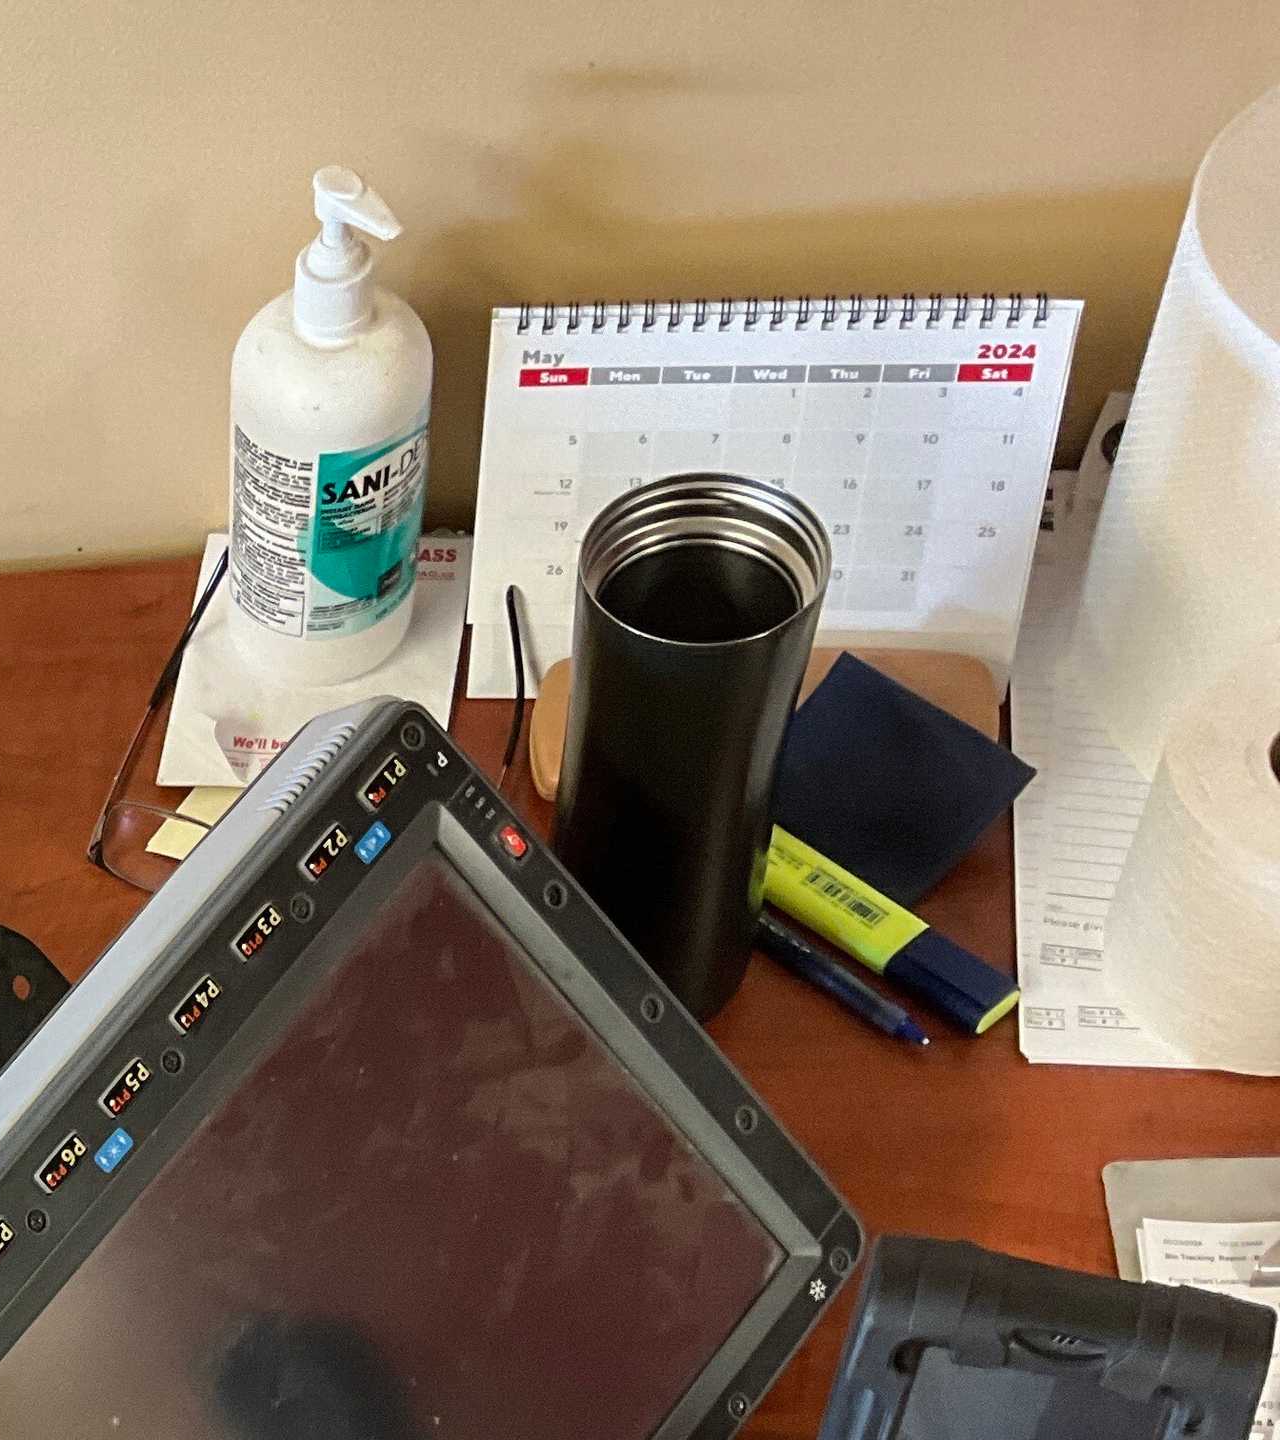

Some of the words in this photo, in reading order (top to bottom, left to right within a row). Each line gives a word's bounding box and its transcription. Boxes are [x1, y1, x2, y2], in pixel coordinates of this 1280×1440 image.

[522, 350, 565, 367] May
[977, 344, 1037, 360] 2024
[540, 372, 568, 383] Sun
[609, 371, 640, 382] Mon
[684, 370, 711, 381] Tue
[753, 369, 788, 380] Wed
[830, 368, 859, 379] Thu
[909, 368, 931, 379] Fri
[981, 368, 1009, 379] Sat
[791, 388, 797, 398] 1
[863, 388, 872, 398] 2
[940, 387, 947, 398] 3
[1013, 387, 1024, 397] 4
[568, 435, 577, 445] 5
[639, 434, 647, 444] 6
[711, 434, 719, 444] 7
[782, 434, 791, 443] 8
[856, 434, 865, 444] 9
[922, 434, 939, 444] 10
[1002, 434, 1015, 444] 11
[559, 479, 573, 489] 12
[843, 479, 857, 490] 16
[917, 480, 932, 490] 17
[991, 481, 1005, 491] 18
[554, 521, 568, 531] 19
[833, 524, 851, 535] 23
[904, 525, 923, 536] 24
[978, 526, 997, 537] 25
[416, 549, 457, 563] ASS
[546, 564, 564, 576] 26
[900, 571, 915, 582] 31
[233, 735, 267, 750] We'll
[383, 759, 407, 785] P1
[322, 828, 349, 856] P2
[258, 907, 282, 935] P3
[195, 979, 220, 1009] P4
[125, 1062, 151, 1092] P5
[61, 1136, 87, 1166] P6
[1181, 1253, 1215, 1262] Tracking
